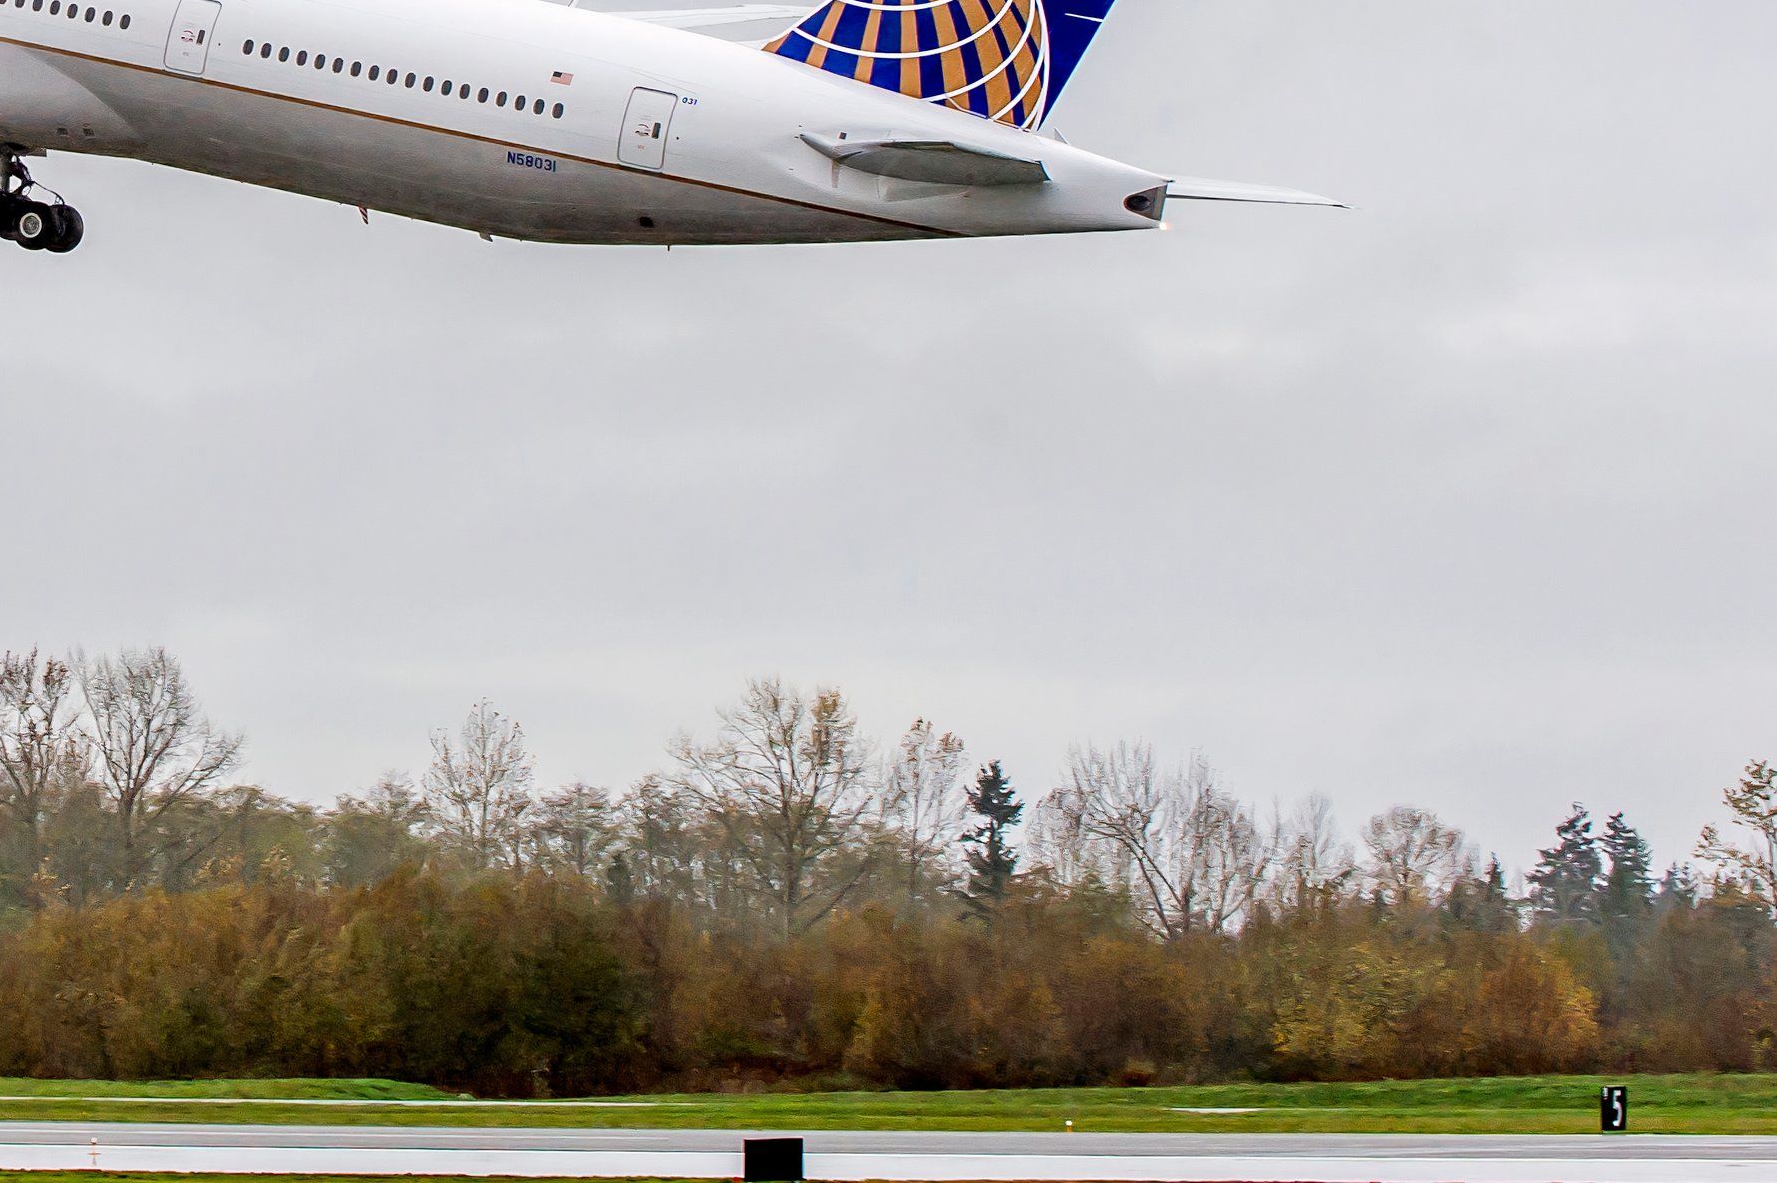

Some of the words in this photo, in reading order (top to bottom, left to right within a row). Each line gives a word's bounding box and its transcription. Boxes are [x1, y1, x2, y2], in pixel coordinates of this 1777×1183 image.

[681, 97, 698, 106] 031
[507, 151, 557, 173] N58031
[1612, 1089, 1623, 1127] 5
